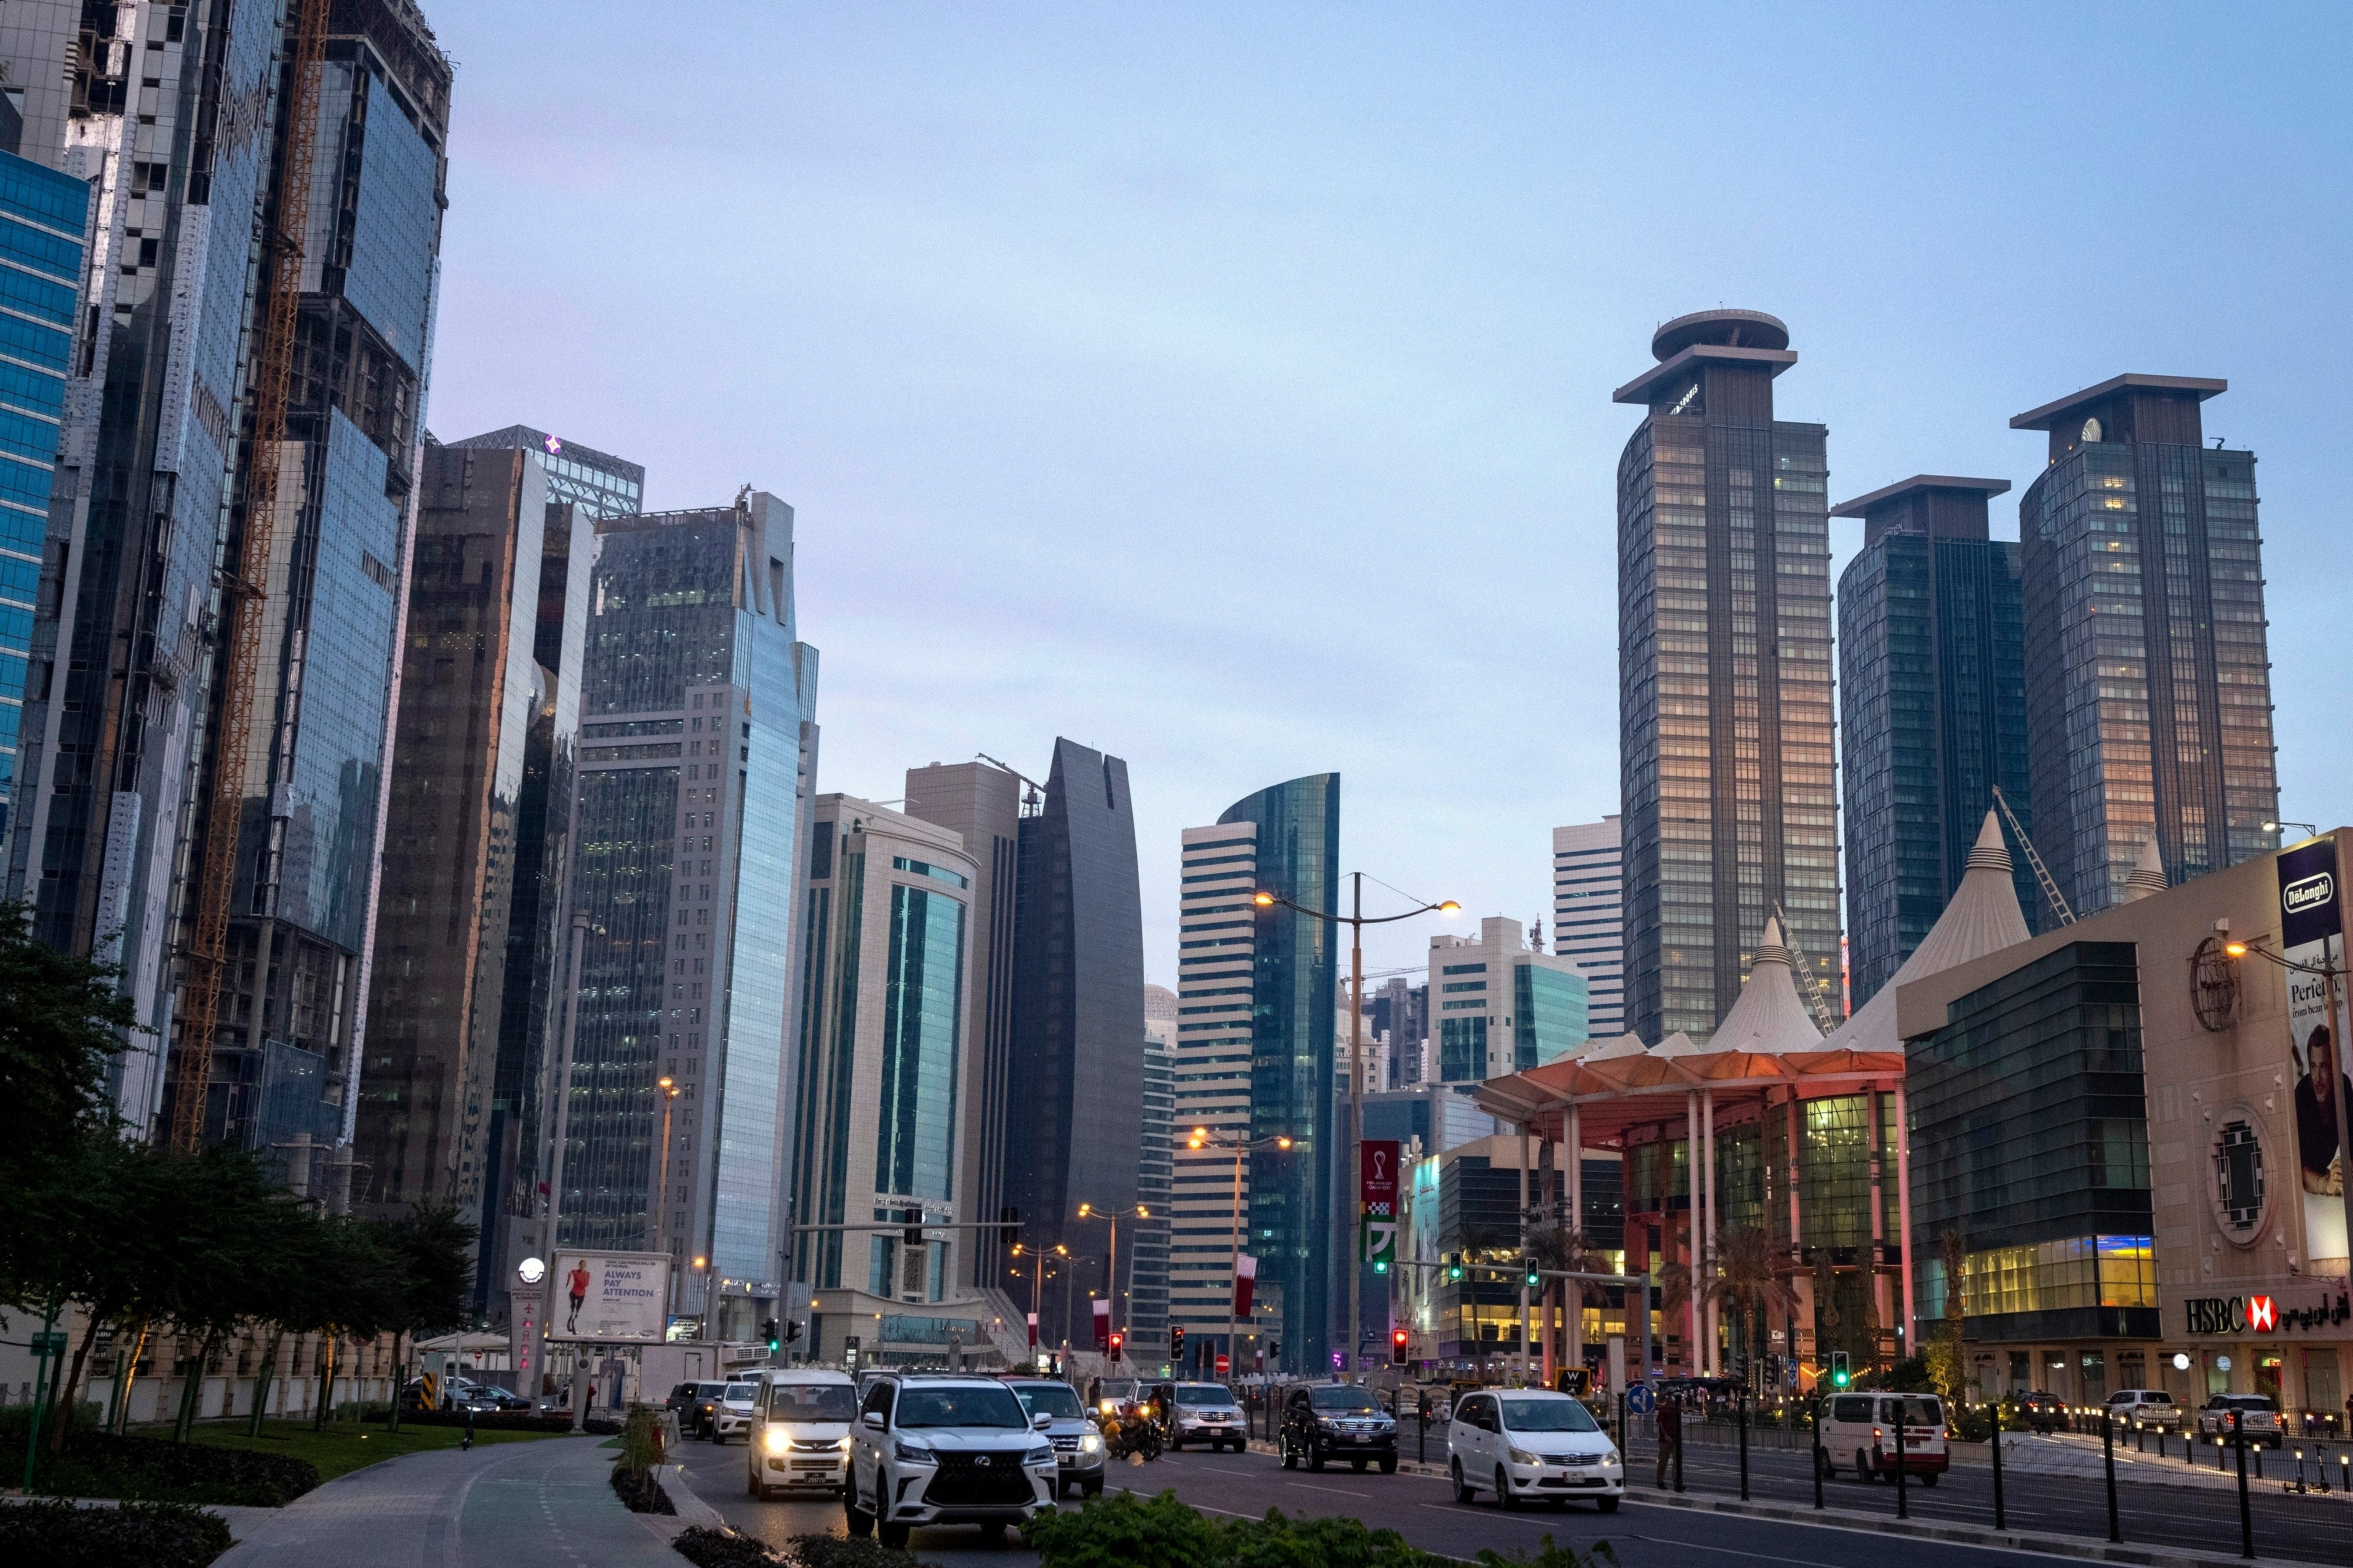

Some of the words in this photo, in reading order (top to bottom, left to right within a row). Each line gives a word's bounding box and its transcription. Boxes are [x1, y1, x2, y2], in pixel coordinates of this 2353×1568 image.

[2291, 978, 2341, 1003] Perfet,
[2308, 1003, 2323, 1015] bean
[604, 1271, 642, 1279] ALWAYS
[603, 1288, 654, 1297] ATTENTION
[2185, 1296, 2246, 1334] HSBC
[1567, 1371, 1579, 1380] W
